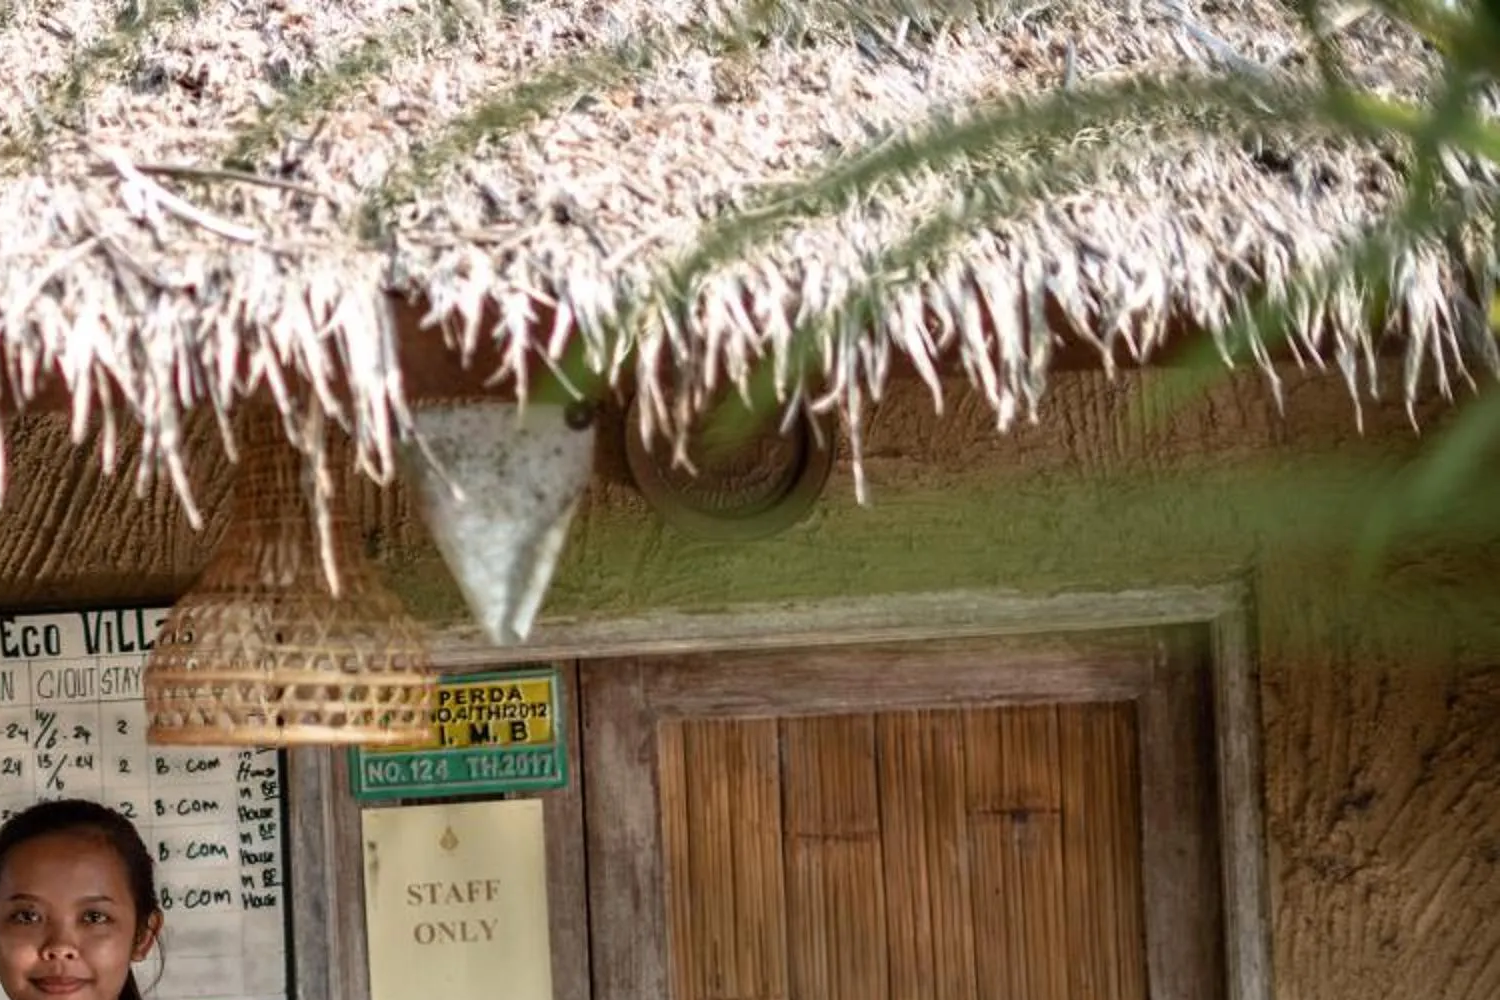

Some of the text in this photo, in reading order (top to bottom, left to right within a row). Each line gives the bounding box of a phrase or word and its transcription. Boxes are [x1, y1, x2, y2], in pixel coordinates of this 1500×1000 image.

[101, 665, 143, 695] STAY
[439, 684, 523, 705] PERDA
[115, 719, 129, 735] 2
[118, 758, 132, 774] 2
[406, 879, 501, 907] STAFF
[413, 918, 499, 946] ONLY
